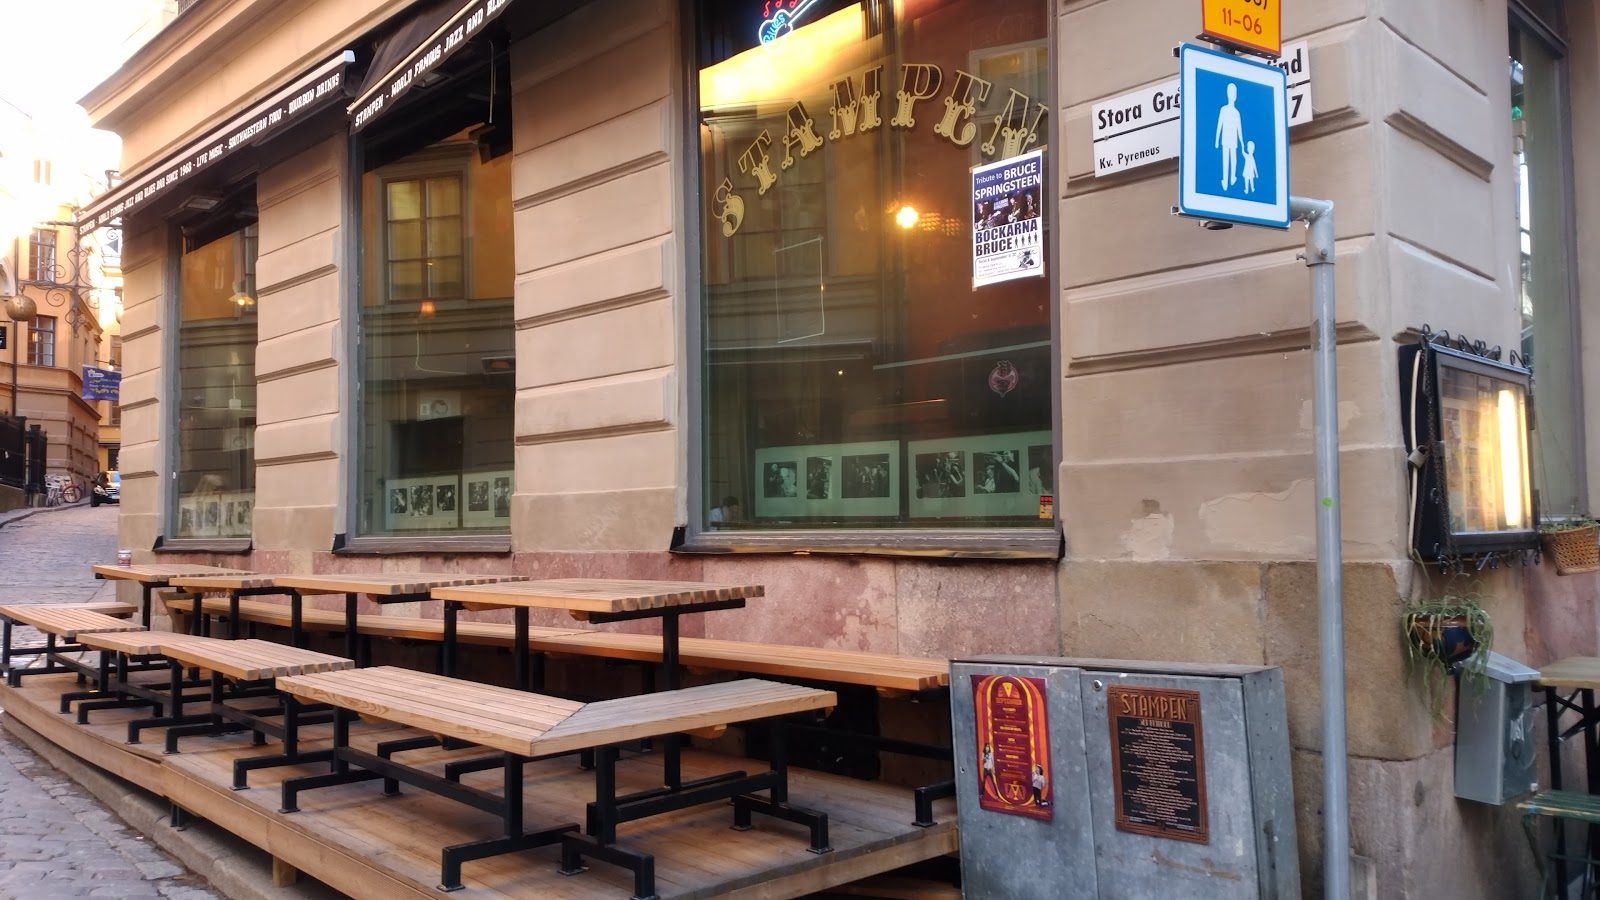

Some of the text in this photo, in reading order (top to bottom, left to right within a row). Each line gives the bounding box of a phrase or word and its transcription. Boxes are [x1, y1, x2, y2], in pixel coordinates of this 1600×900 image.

[1222, 8, 1262, 35] 11-06
[355, 94, 383, 127] STAMPEN
[391, 69, 412, 98] WORLD
[414, 44, 442, 78] FAMOUS
[444, 24, 464, 52] JAZZ
[466, 7, 483, 34] AND
[1098, 104, 1142, 130] Stora
[1291, 94, 1304, 119] 7
[110, 202, 124, 217] FAMOUS
[124, 196, 134, 210] JAZZ
[134, 190, 143, 203] AND
[144, 183, 156, 198] BLUES
[166, 170, 178, 185] SINCE
[180, 162, 192, 177] 1968
[197, 152, 207, 168] LIVE
[209, 143, 224, 161] MUSIC
[228, 117, 267, 149] SOUTHWESTERN
[268, 108, 282, 125] FOOD
[289, 89, 315, 115] BOURBON
[316, 73, 340, 98] DRINKS
[711, 63, 1050, 237] STAMPEN
[1099, 146, 1160, 169] Kv. Pyreneus
[975, 173, 1041, 200] SPRINGSTEEN
[976, 162, 1037, 185] Tribute to BRUCE
[975, 219, 1038, 245] BOCKARNA
[975, 238, 1013, 257] BRUCE
[1120, 693, 1187, 720] STAMPEN
